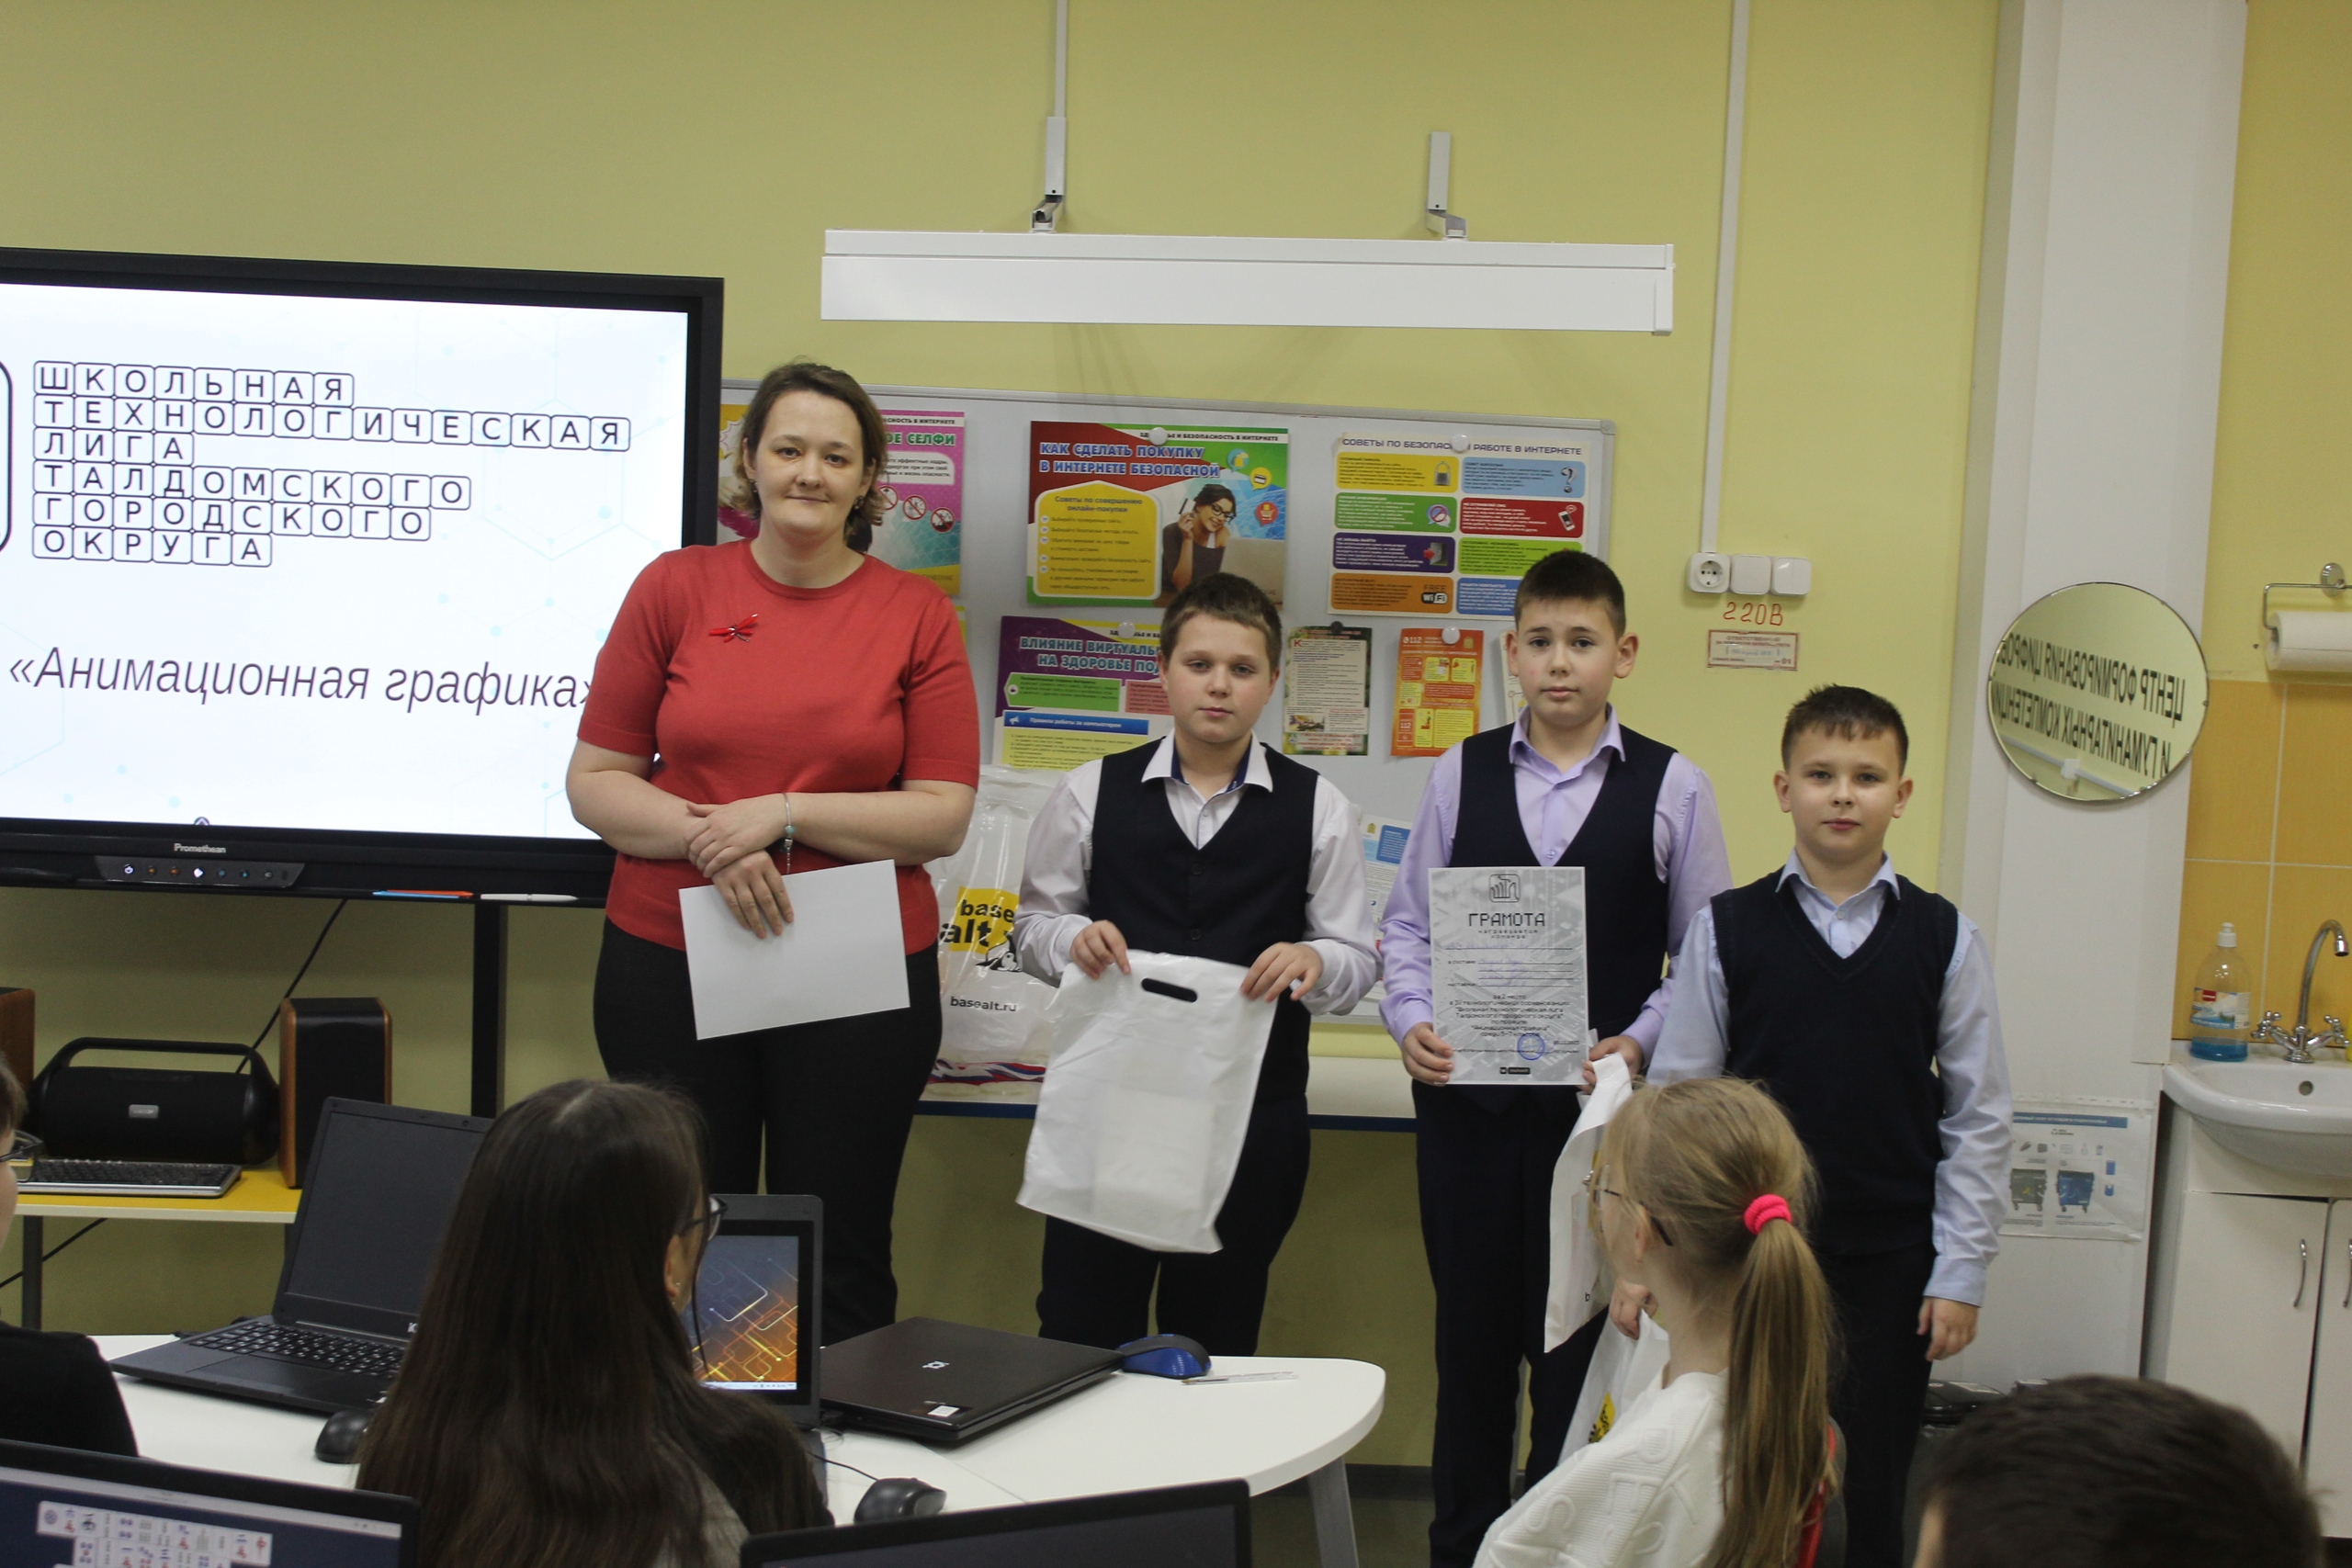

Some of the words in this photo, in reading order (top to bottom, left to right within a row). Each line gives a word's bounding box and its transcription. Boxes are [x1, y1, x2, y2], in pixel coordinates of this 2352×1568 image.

[40, 365, 345, 402] ШКОЛЬНАЯ
[43, 400, 620, 446] ТЕХНОЛОГИЧЕСКАЯ
[43, 433, 185, 460] ЛИГА
[908, 433, 956, 446] СЕЛФИ
[1342, 438, 1385, 447] СОВЕТЫ
[1387, 440, 1401, 448] ПО
[1474, 444, 1511, 453] РАБОТЕ
[1524, 446, 1582, 456] ИНТЕРНЕТЕ
[1040, 443, 1070, 456] КАК
[1073, 444, 1132, 457] СДЕЛАТЬ
[1136, 446, 1205, 459] ПОКУПКУ
[1040, 461, 1050, 473] В
[1054, 461, 1125, 475] ИНТЕРНЕТЕ
[1130, 463, 1220, 478] БЕЗОПАСНОЙ
[44, 465, 462, 502] ТАЛДОМСКОГО
[46, 498, 423, 535] ГОРОДСКОГО
[42, 530, 262, 561] ОКРУГА
[1423, 584, 1447, 592] FREE
[1020, 637, 1082, 651] ВЛИЯНИЕ
[1409, 636, 1422, 644] 112
[1037, 653, 1057, 667] НА
[1061, 655, 1131, 671] ЗДОРОВЬЕ
[9, 646, 369, 705] «Анимационная
[174, 842, 226, 853] Promethean
[960, 899, 1014, 922] base
[1468, 912, 1545, 927] ГРАМОТА
[939, 919, 991, 947] alt
[950, 996, 1017, 1012] basealt.ru
